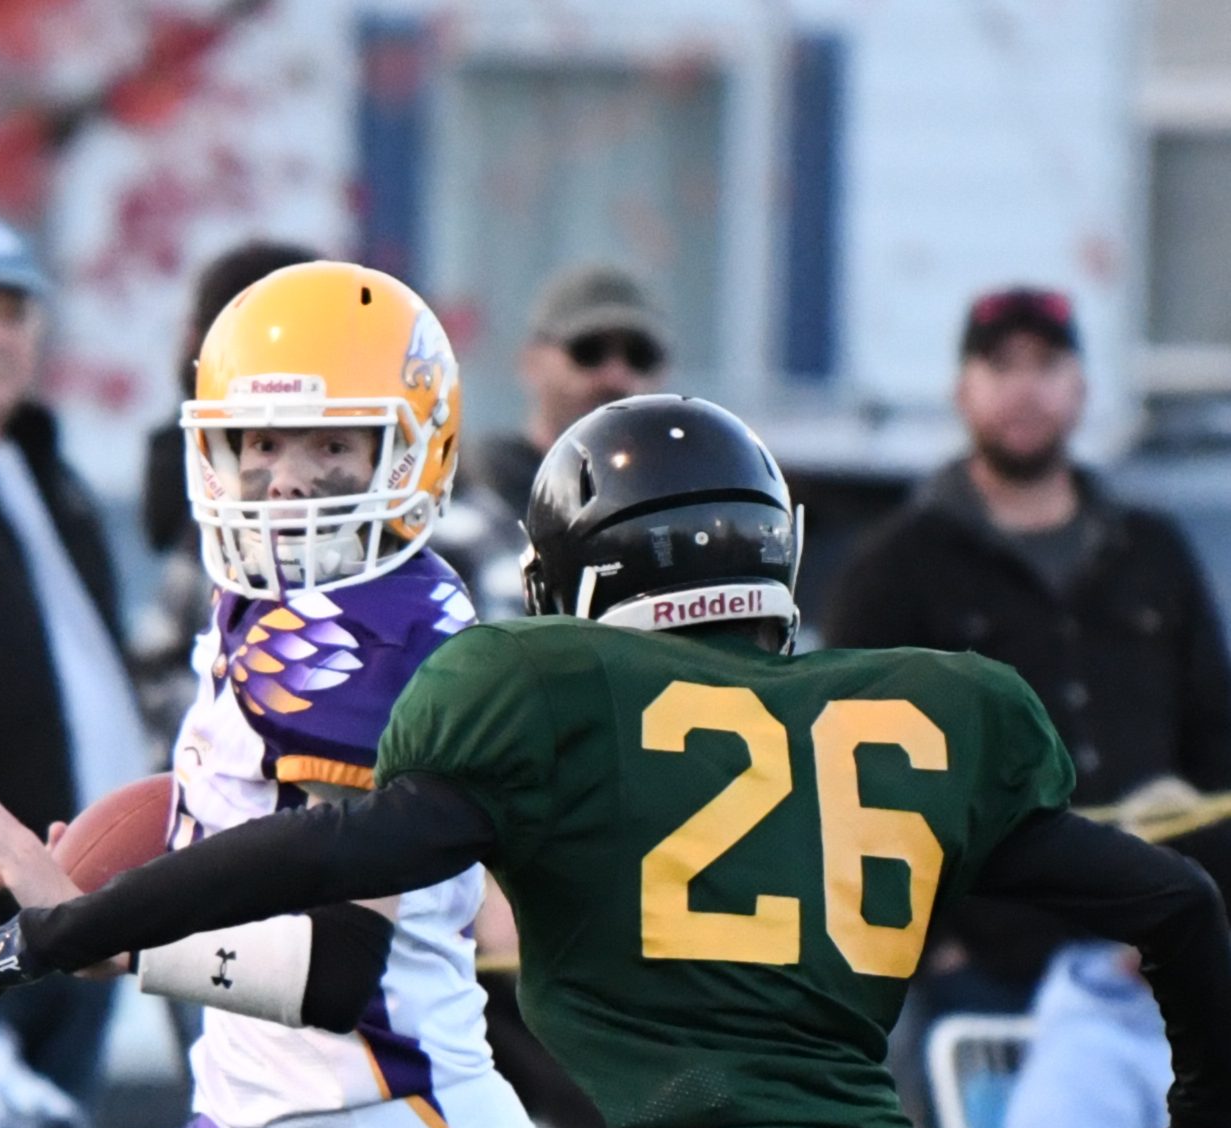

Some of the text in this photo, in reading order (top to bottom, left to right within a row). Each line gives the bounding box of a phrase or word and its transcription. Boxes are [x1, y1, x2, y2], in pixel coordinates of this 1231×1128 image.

[251, 380, 302, 393] Riddell
[653, 590, 762, 622] Riddell
[640, 680, 948, 978] 26
